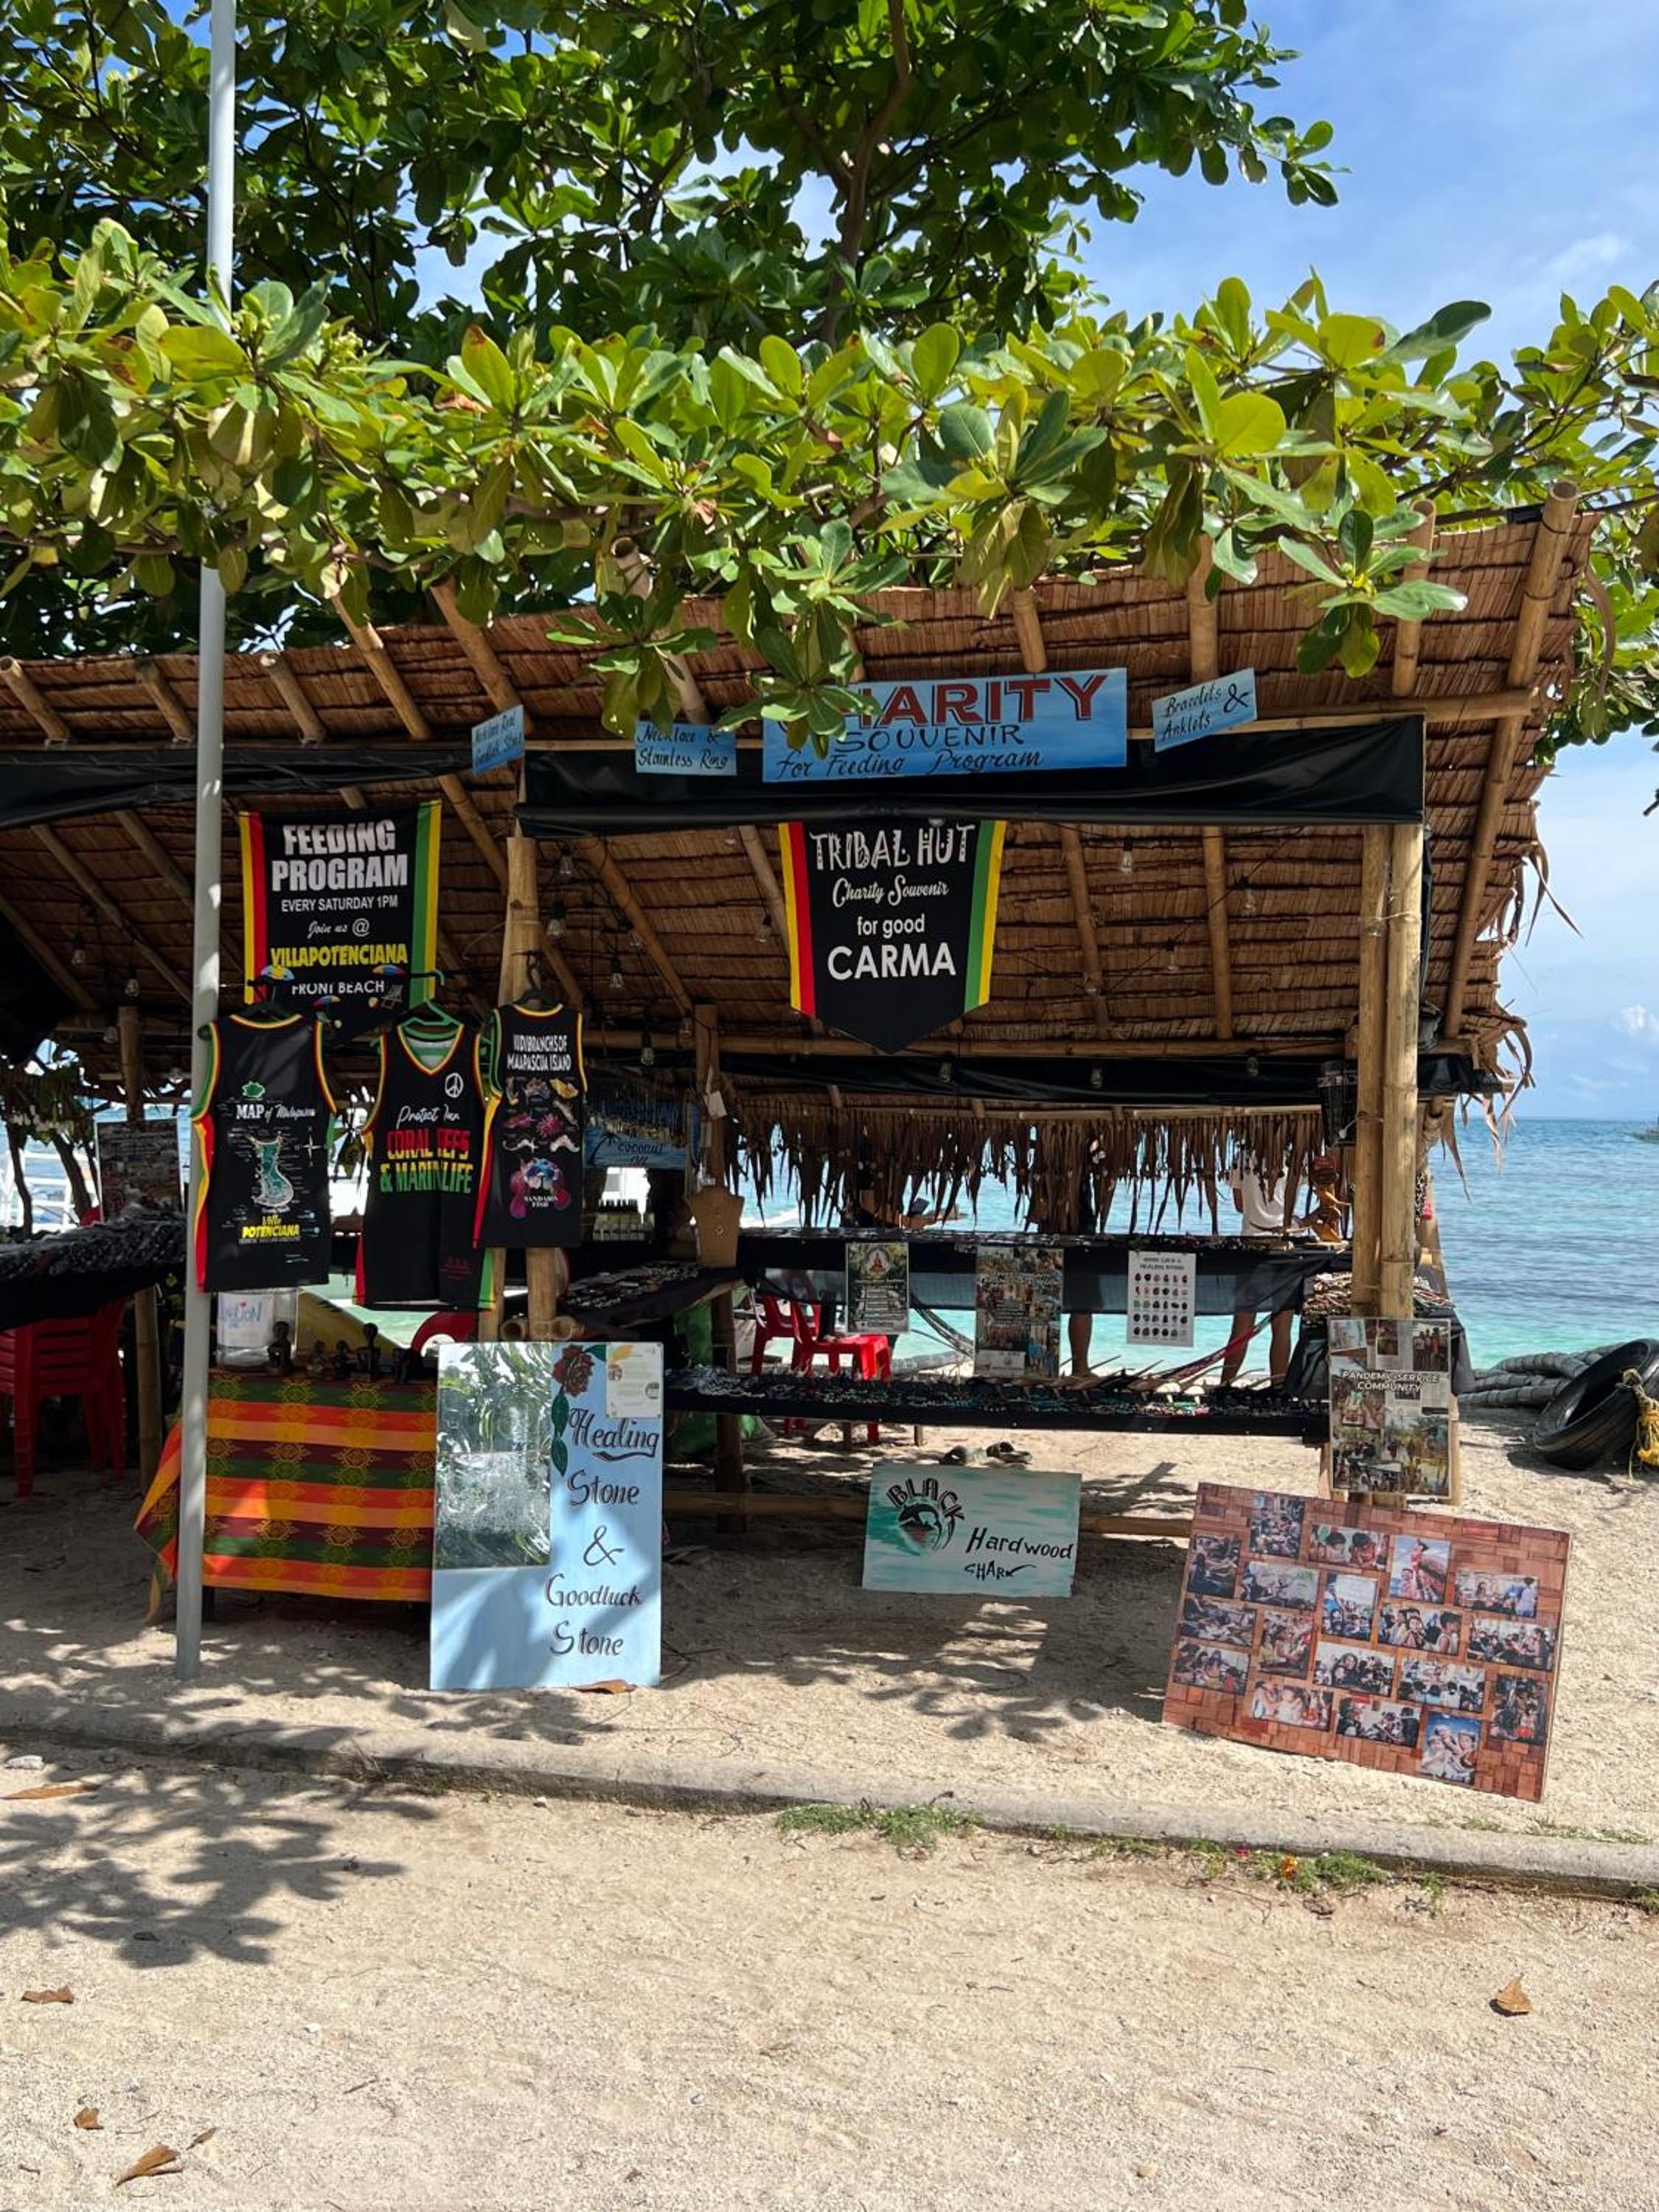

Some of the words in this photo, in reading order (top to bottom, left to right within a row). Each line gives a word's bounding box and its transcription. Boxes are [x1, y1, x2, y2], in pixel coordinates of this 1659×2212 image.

[1223, 684, 1250, 714] &
[833, 724, 1024, 754] SOUVENIR
[776, 749, 813, 779] for
[824, 753, 907, 779] Feeding
[926, 748, 1040, 774] Program
[283, 819, 397, 855] FEEDING
[809, 830, 911, 870] TRIBAL
[917, 824, 975, 866] HUT
[271, 854, 408, 891] PROGRAM
[281, 899, 316, 912] EVERY
[318, 896, 374, 911] SATURDAY
[377, 894, 399, 908] 1PM
[832, 877, 884, 908] Charity
[887, 874, 950, 906] Souvenir
[307, 921, 332, 939] Join
[334, 925, 348, 933] us
[352, 918, 370, 937] @
[857, 916, 877, 936] for
[883, 914, 925, 939] good
[271, 943, 408, 967] VILLAPOTENCIANA
[827, 942, 956, 981] CARMA
[338, 980, 385, 994] BEACH
[236, 1105, 264, 1119] MAP
[264, 1107, 274, 1124] of
[387, 1128, 434, 1160] CORAL
[380, 1164, 393, 1192] &
[242, 1224, 300, 1238] POTENCIANA
[1357, 1380, 1422, 1393] COMMUNITY
[1397, 1374, 1440, 1384] SERVICE
[569, 1407, 661, 1460] Healing
[567, 1470, 640, 1506] Stone
[886, 1477, 965, 1520] BLACK
[583, 1525, 625, 1567] &
[965, 1526, 1075, 1559] Hardwood
[546, 1573, 643, 1607] Goodluck
[549, 1620, 625, 1656] Stone
